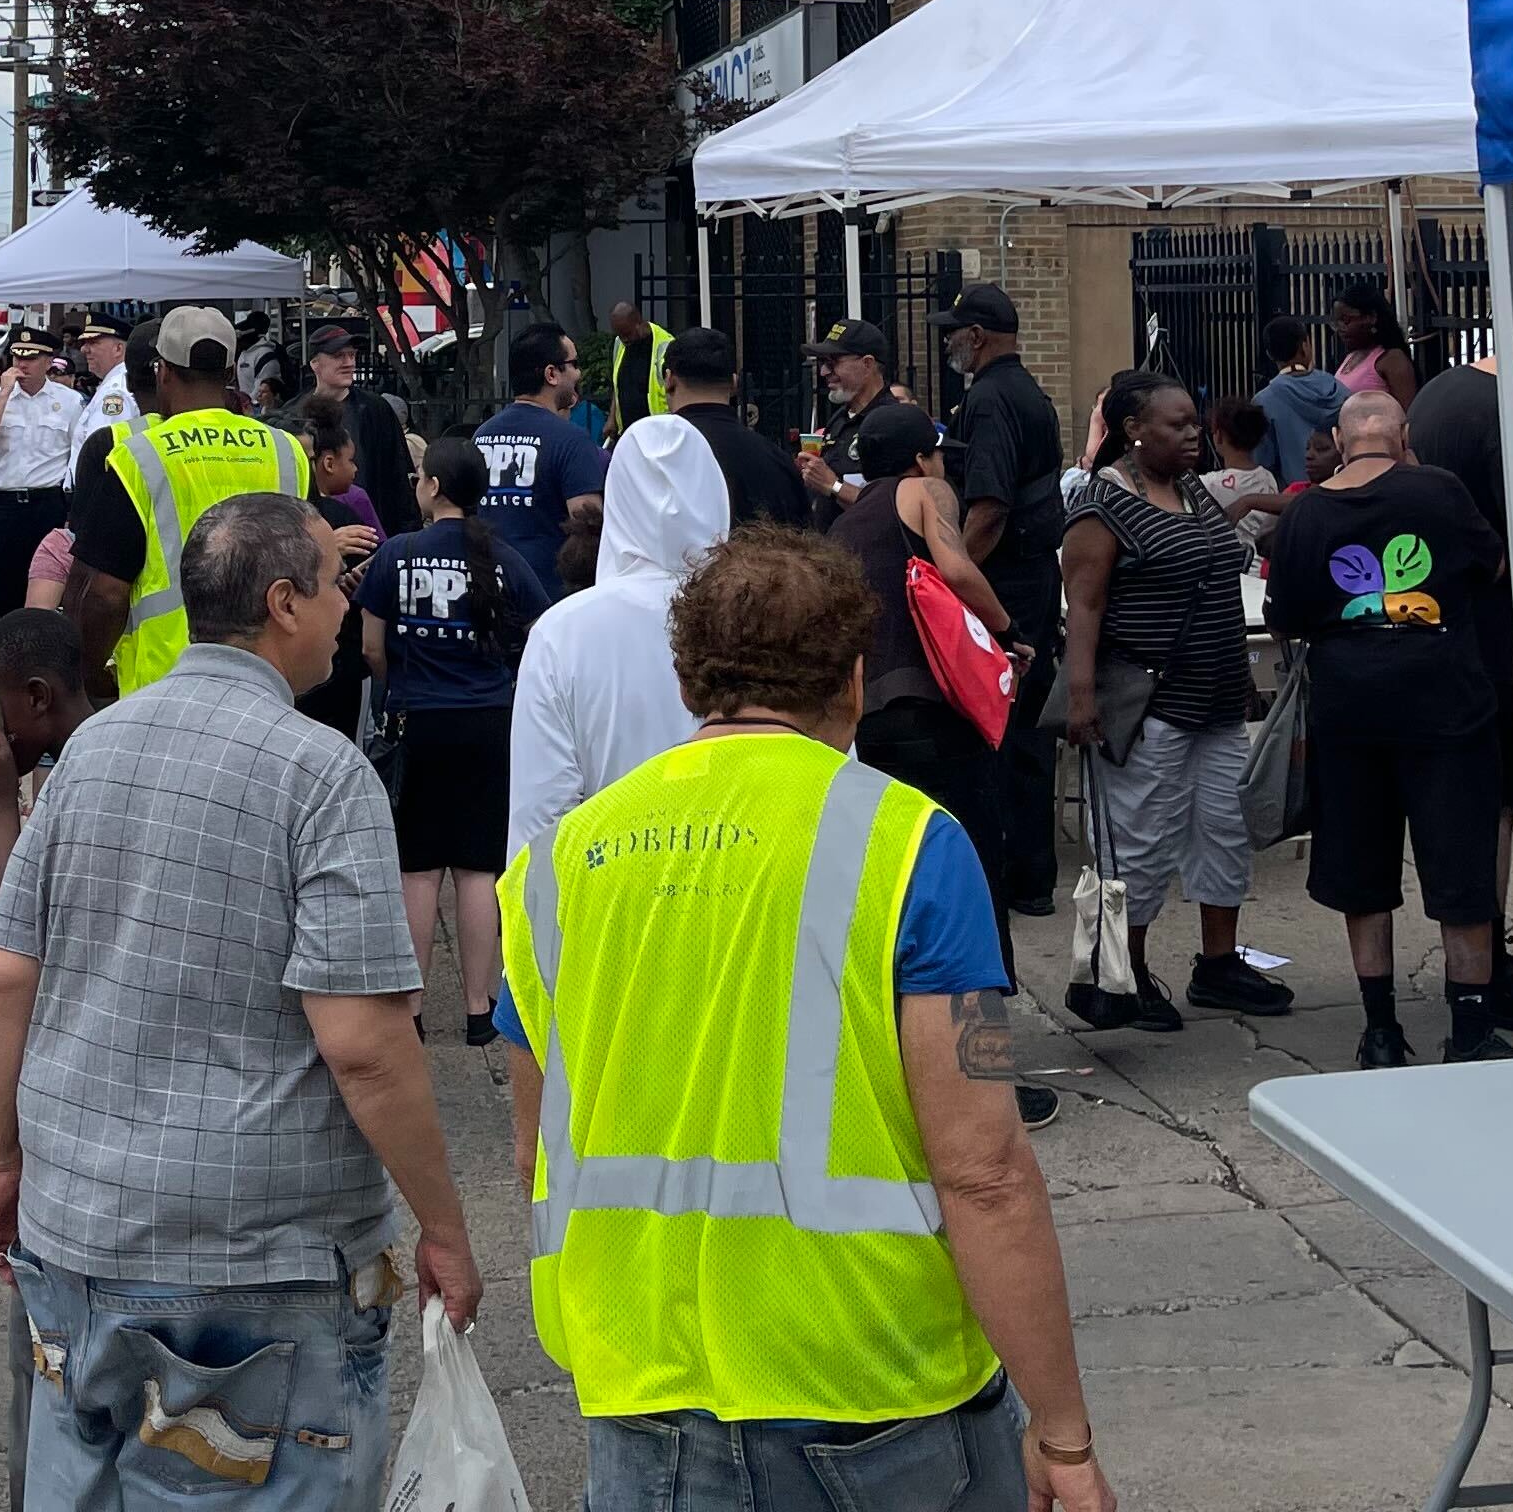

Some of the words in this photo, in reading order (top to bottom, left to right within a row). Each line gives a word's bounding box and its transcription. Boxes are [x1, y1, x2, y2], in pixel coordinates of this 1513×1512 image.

[160, 428, 267, 456] IMPACT
[474, 435, 541, 446] PHILADELPHIA
[477, 444, 538, 487] PPD
[480, 495, 533, 507] OLICE
[397, 624, 475, 641] POLIC
